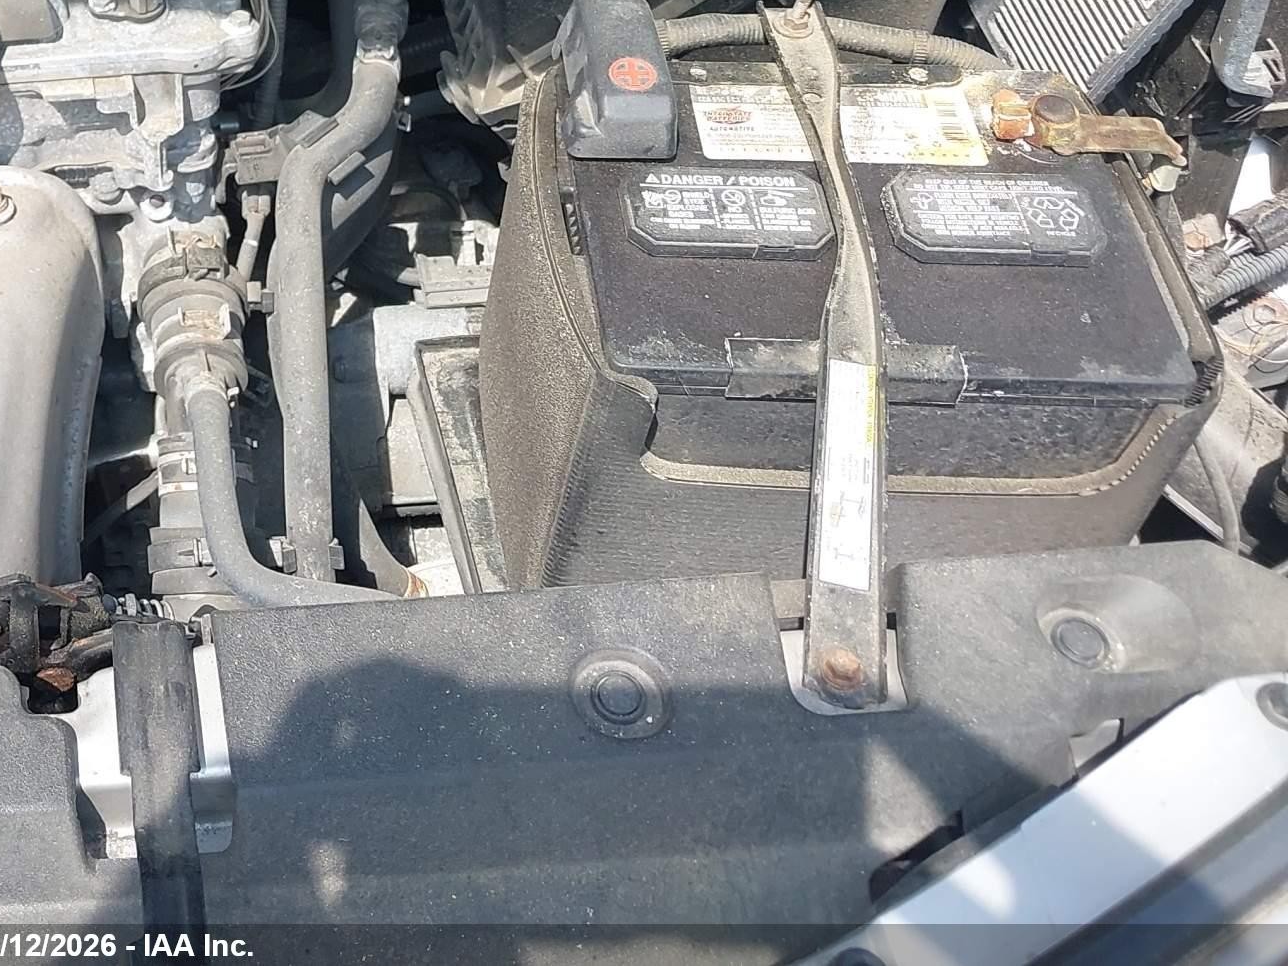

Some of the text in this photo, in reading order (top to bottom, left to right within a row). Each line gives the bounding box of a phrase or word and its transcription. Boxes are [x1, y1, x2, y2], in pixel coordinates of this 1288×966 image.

[660, 174, 796, 187] DANGER / POISON
